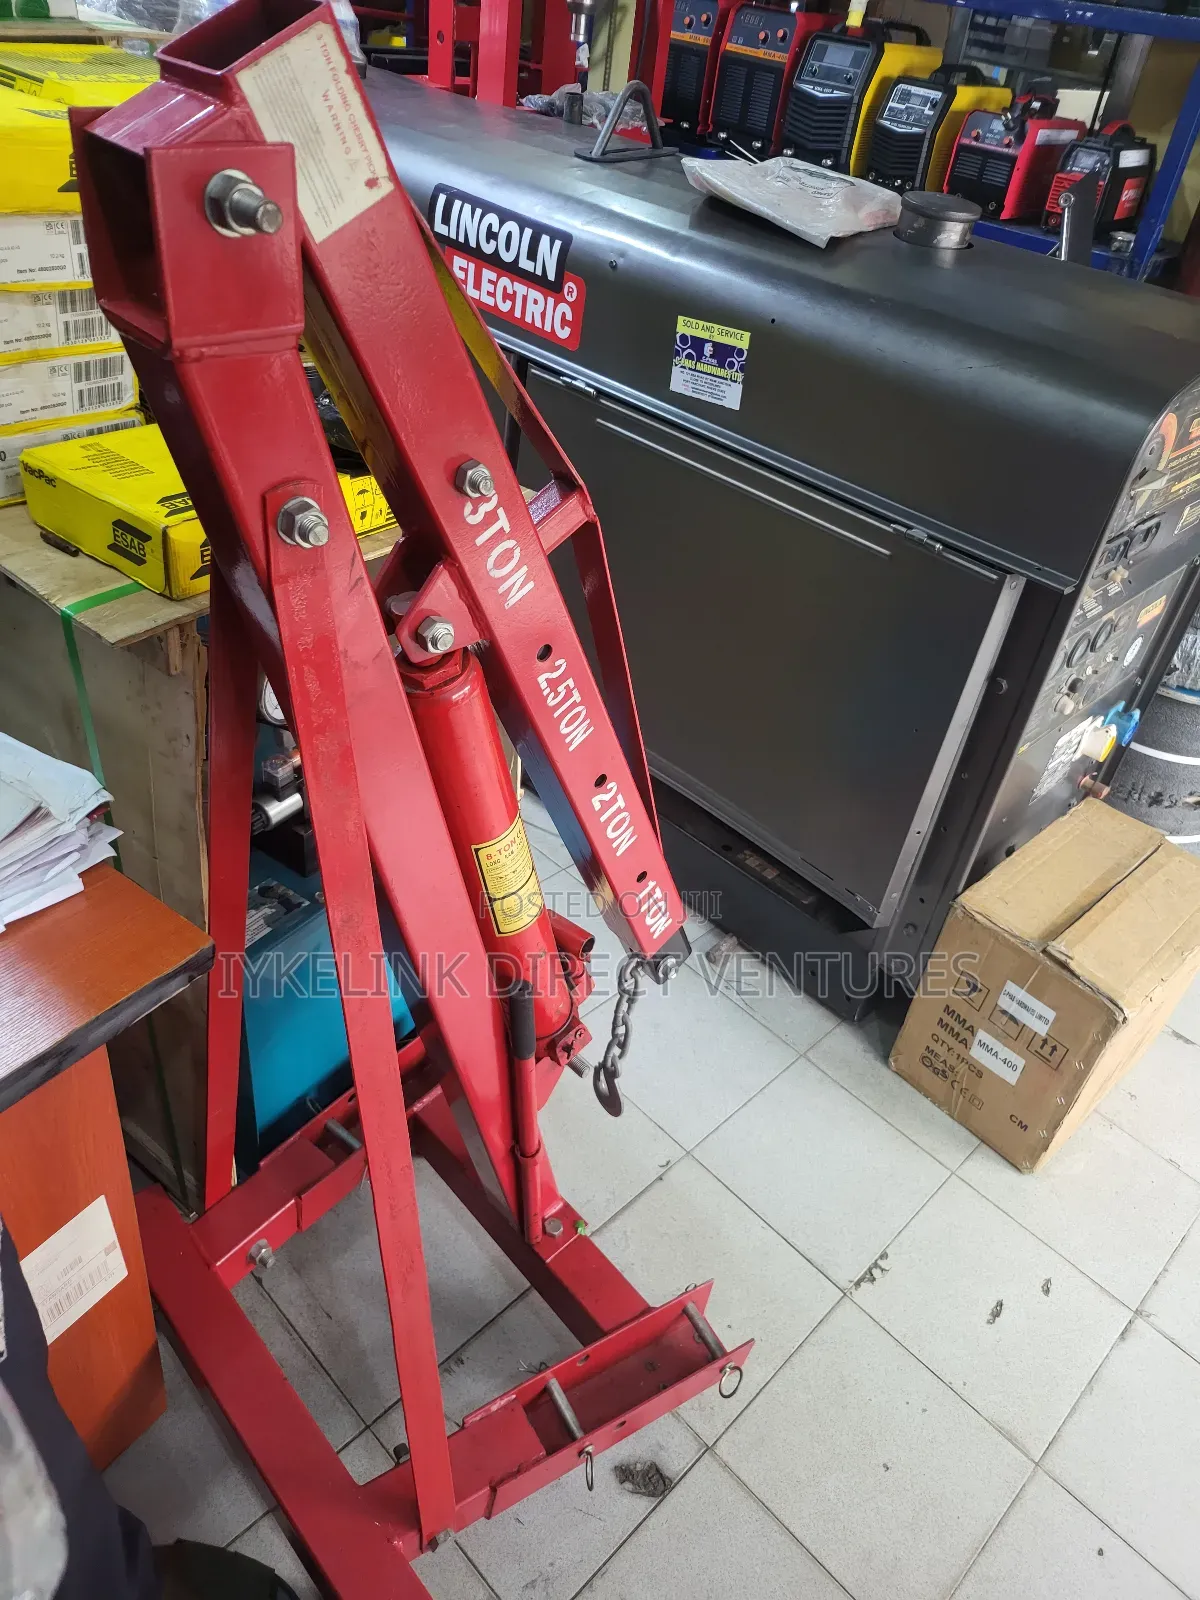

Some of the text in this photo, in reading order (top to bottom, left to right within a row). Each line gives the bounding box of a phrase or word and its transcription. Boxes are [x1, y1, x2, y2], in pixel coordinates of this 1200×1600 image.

[321, 89, 351, 156] WARNING
[433, 193, 563, 282] LINCOLN
[452, 255, 573, 340] ELECTRIC
[682, 319, 745, 341] SOLD AND SERVICE
[696, 361, 731, 379] HARDWARES
[20, 460, 57, 488] VacPac
[112, 527, 147, 558] ESAB
[464, 489, 535, 610] 3TON
[592, 782, 638, 857] 2TON
[486, 837, 516, 860] 8-TON
[636, 880, 673, 939] 1TON
[1035, 1011, 1050, 1026] LIMITED
[977, 1039, 1018, 1073] MMA-400
[1009, 1113, 1029, 1132] CM
